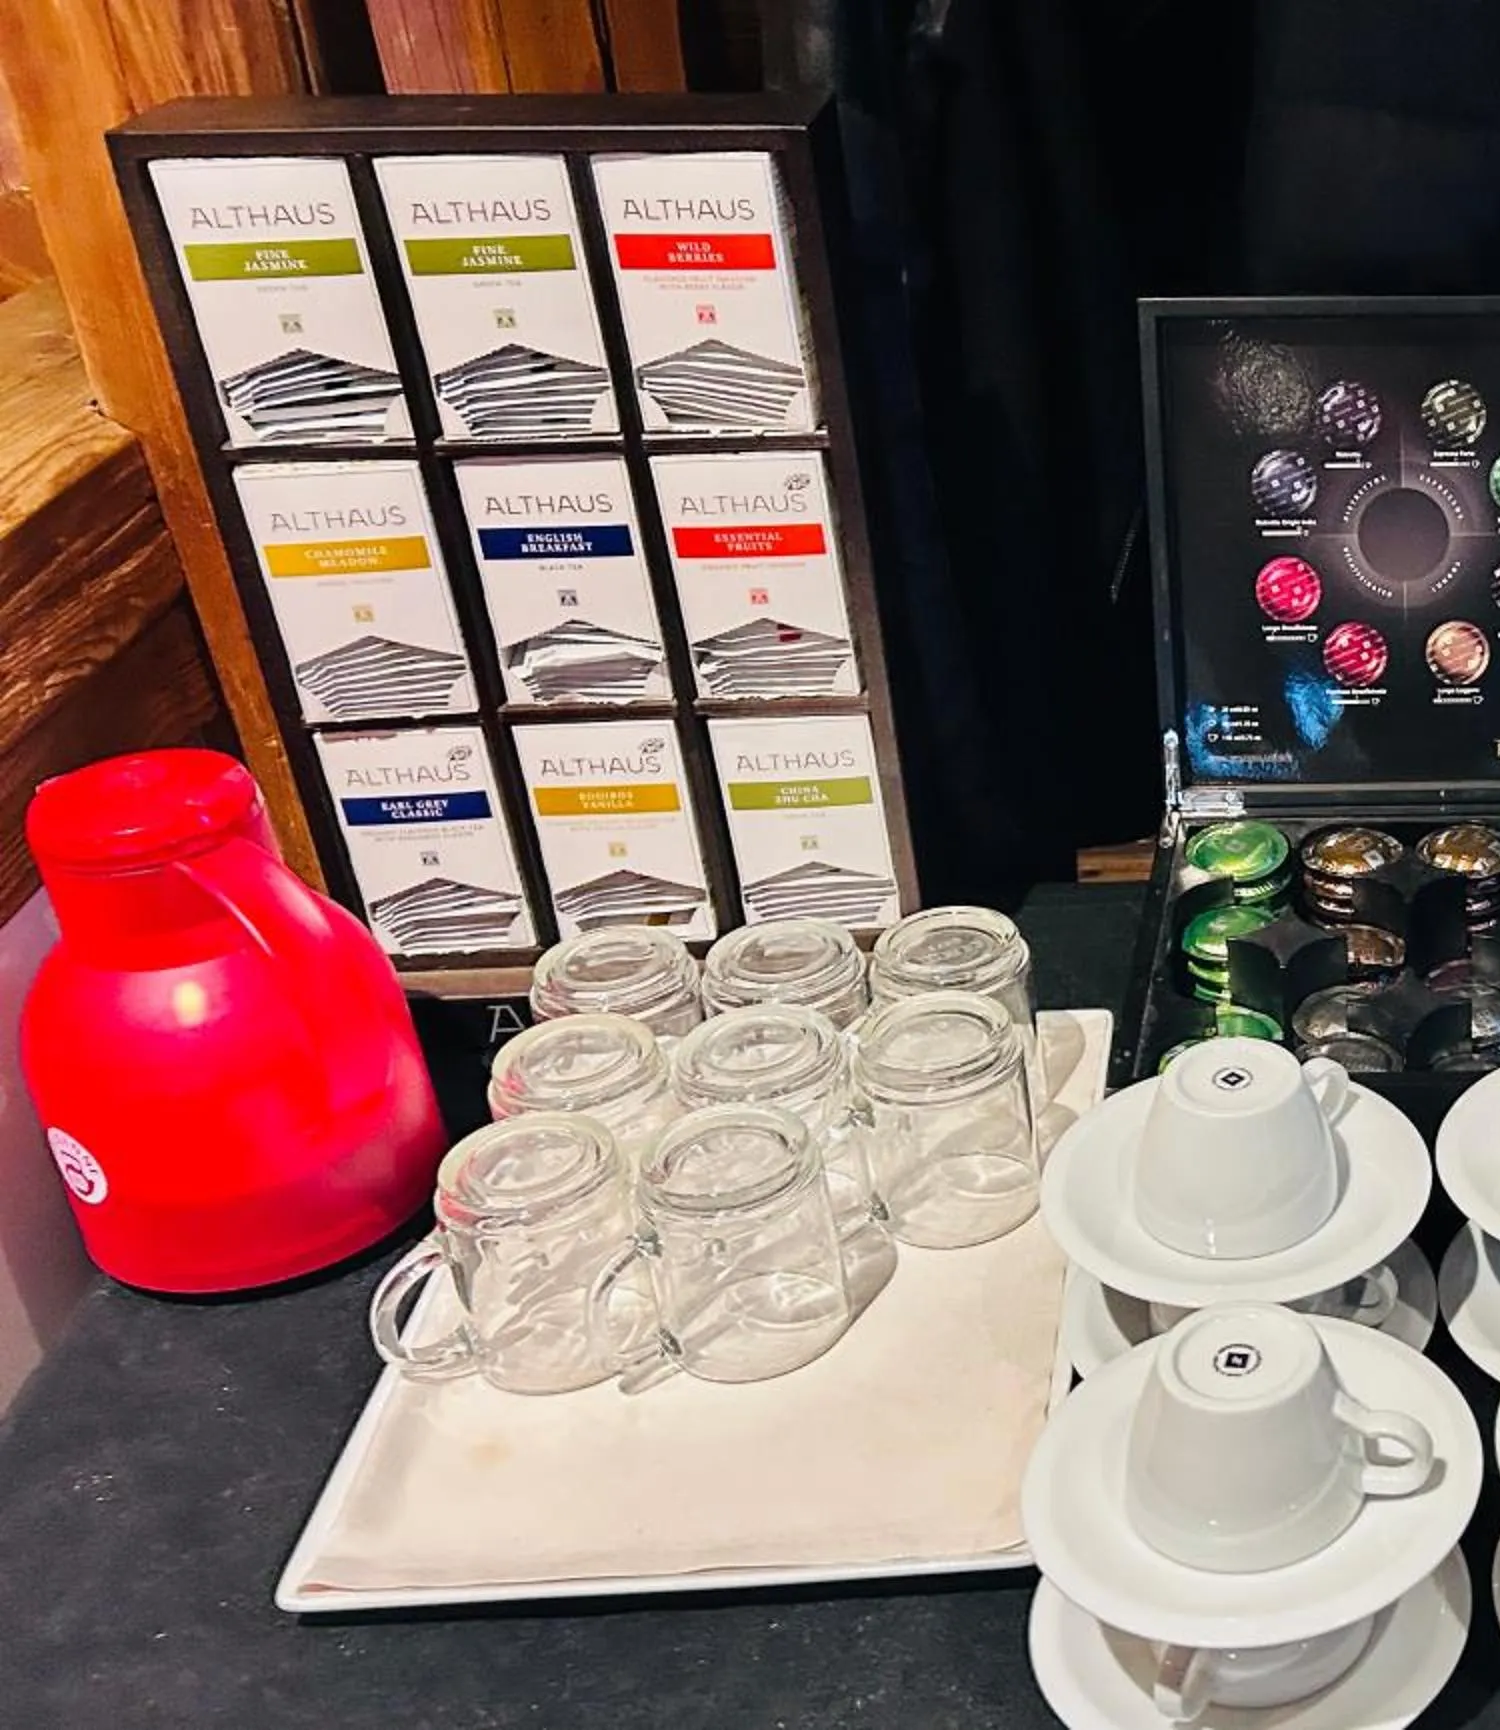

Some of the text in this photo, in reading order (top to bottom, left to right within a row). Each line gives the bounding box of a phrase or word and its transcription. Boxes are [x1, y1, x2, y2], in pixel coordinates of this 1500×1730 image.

[190, 202, 336, 229] ALTHAUS
[411, 199, 551, 224] ALTHAUS
[623, 199, 755, 221] ALTHAUS
[472, 245, 506, 255] FINE
[675, 242, 711, 252] WILD
[255, 249, 290, 261] FINE
[461, 255, 523, 267] JASMINE
[667, 252, 725, 263] BERRIES
[243, 259, 308, 272] JASMINE
[486, 493, 613, 515] ALTHAUS
[681, 493, 808, 516] ALTHAUS
[271, 505, 407, 532] ALTHAUS
[526, 532, 583, 543] ENGLISH
[713, 531, 784, 543] ESSENTIAL
[521, 541, 593, 553] BREAKFAST
[727, 542, 773, 551] FRUITS
[541, 755, 661, 777] ALTHAUS
[737, 749, 855, 772] ALTHAUS
[347, 763, 471, 787] ALTHAUS
[381, 799, 449, 811] EARL GREY
[391, 809, 443, 819] CLASSIC
